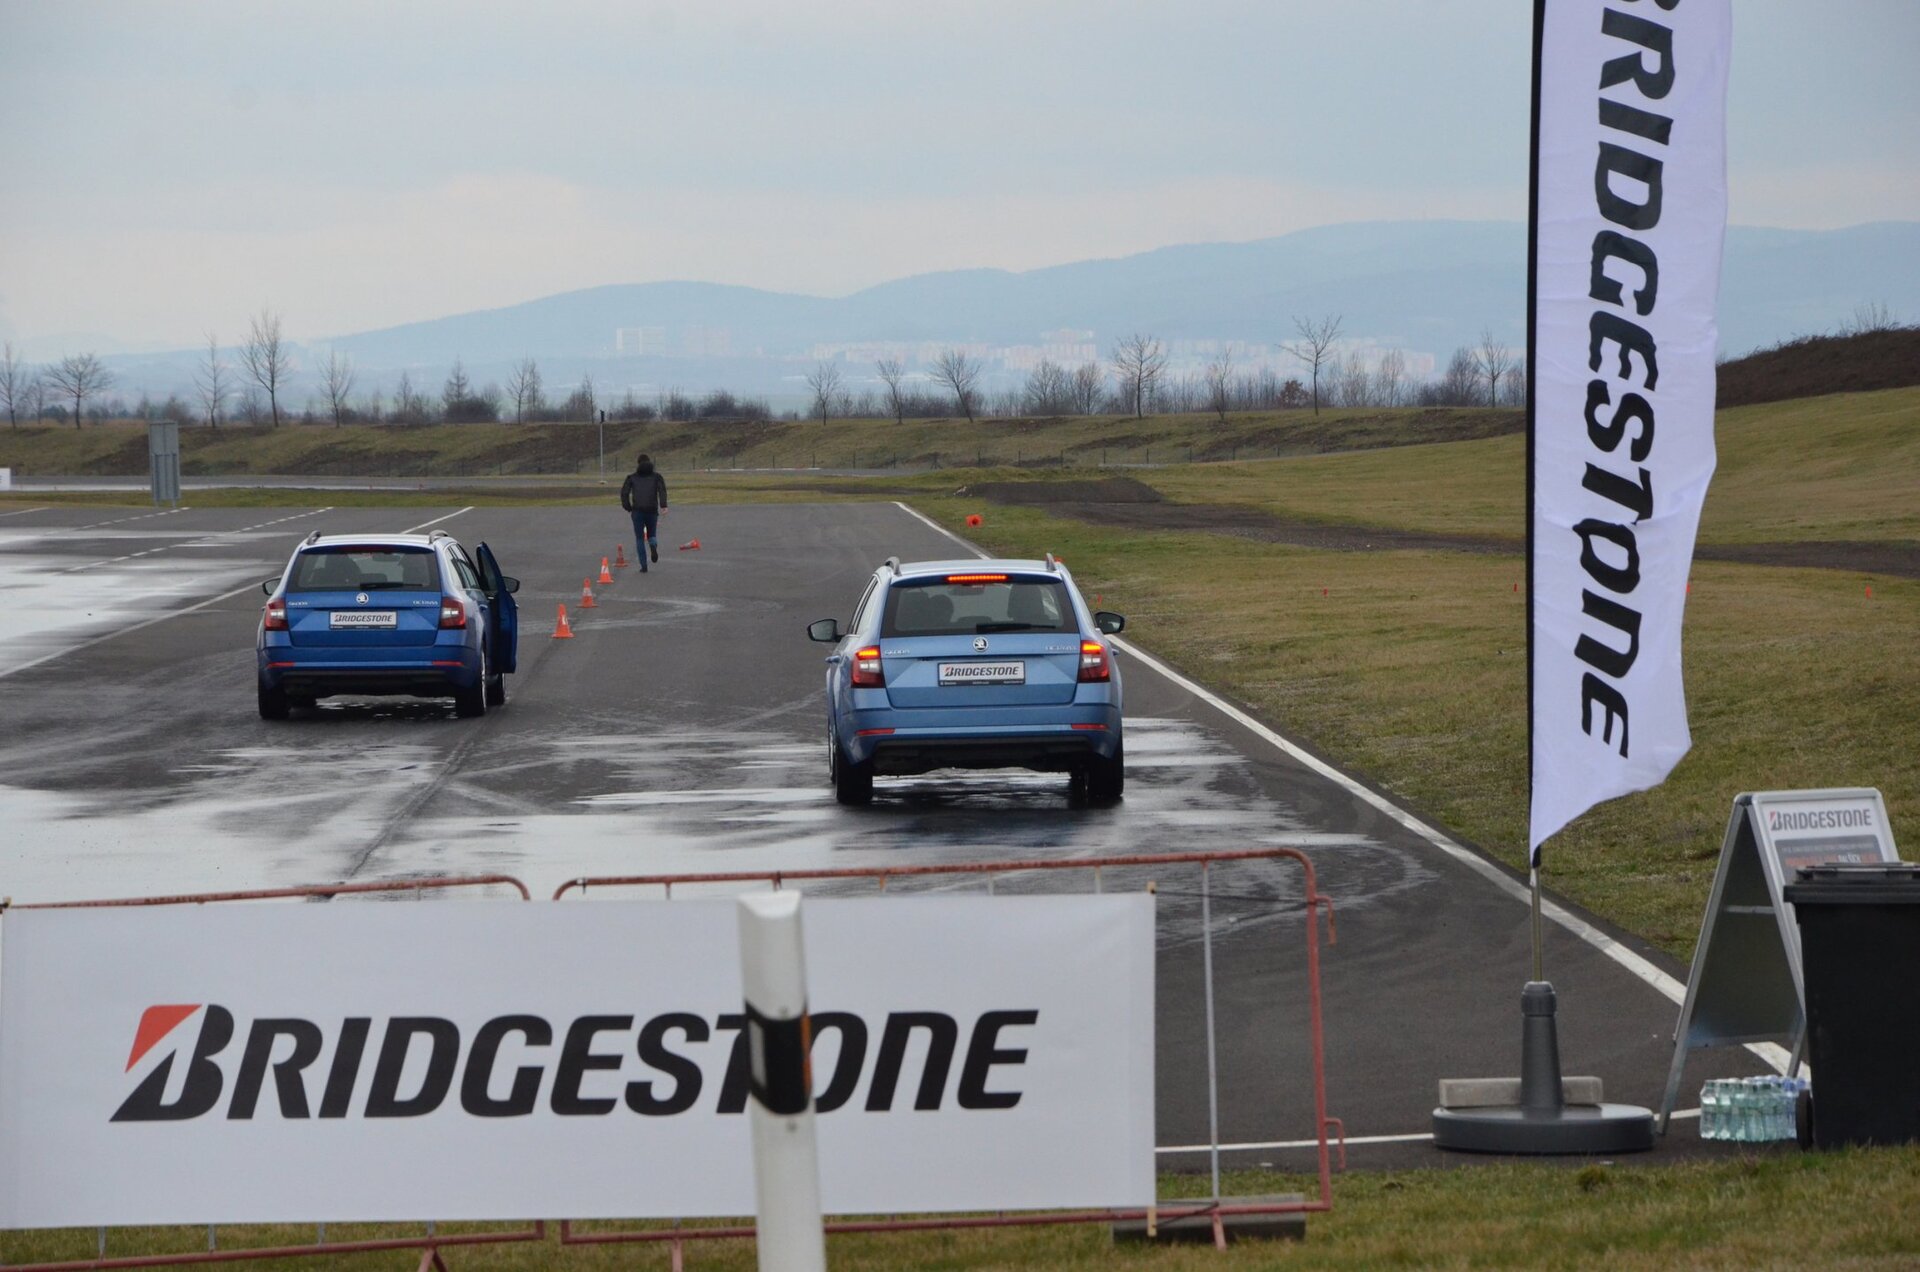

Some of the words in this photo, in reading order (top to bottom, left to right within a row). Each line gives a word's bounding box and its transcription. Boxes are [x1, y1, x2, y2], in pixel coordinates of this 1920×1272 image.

[1572, 0, 1679, 760] RIDGESTONE
[334, 614, 393, 623] BRIDGESTONE
[944, 666, 1020, 677] BRIDGESTONE
[1769, 809, 1872, 831] BRIDGESTONE
